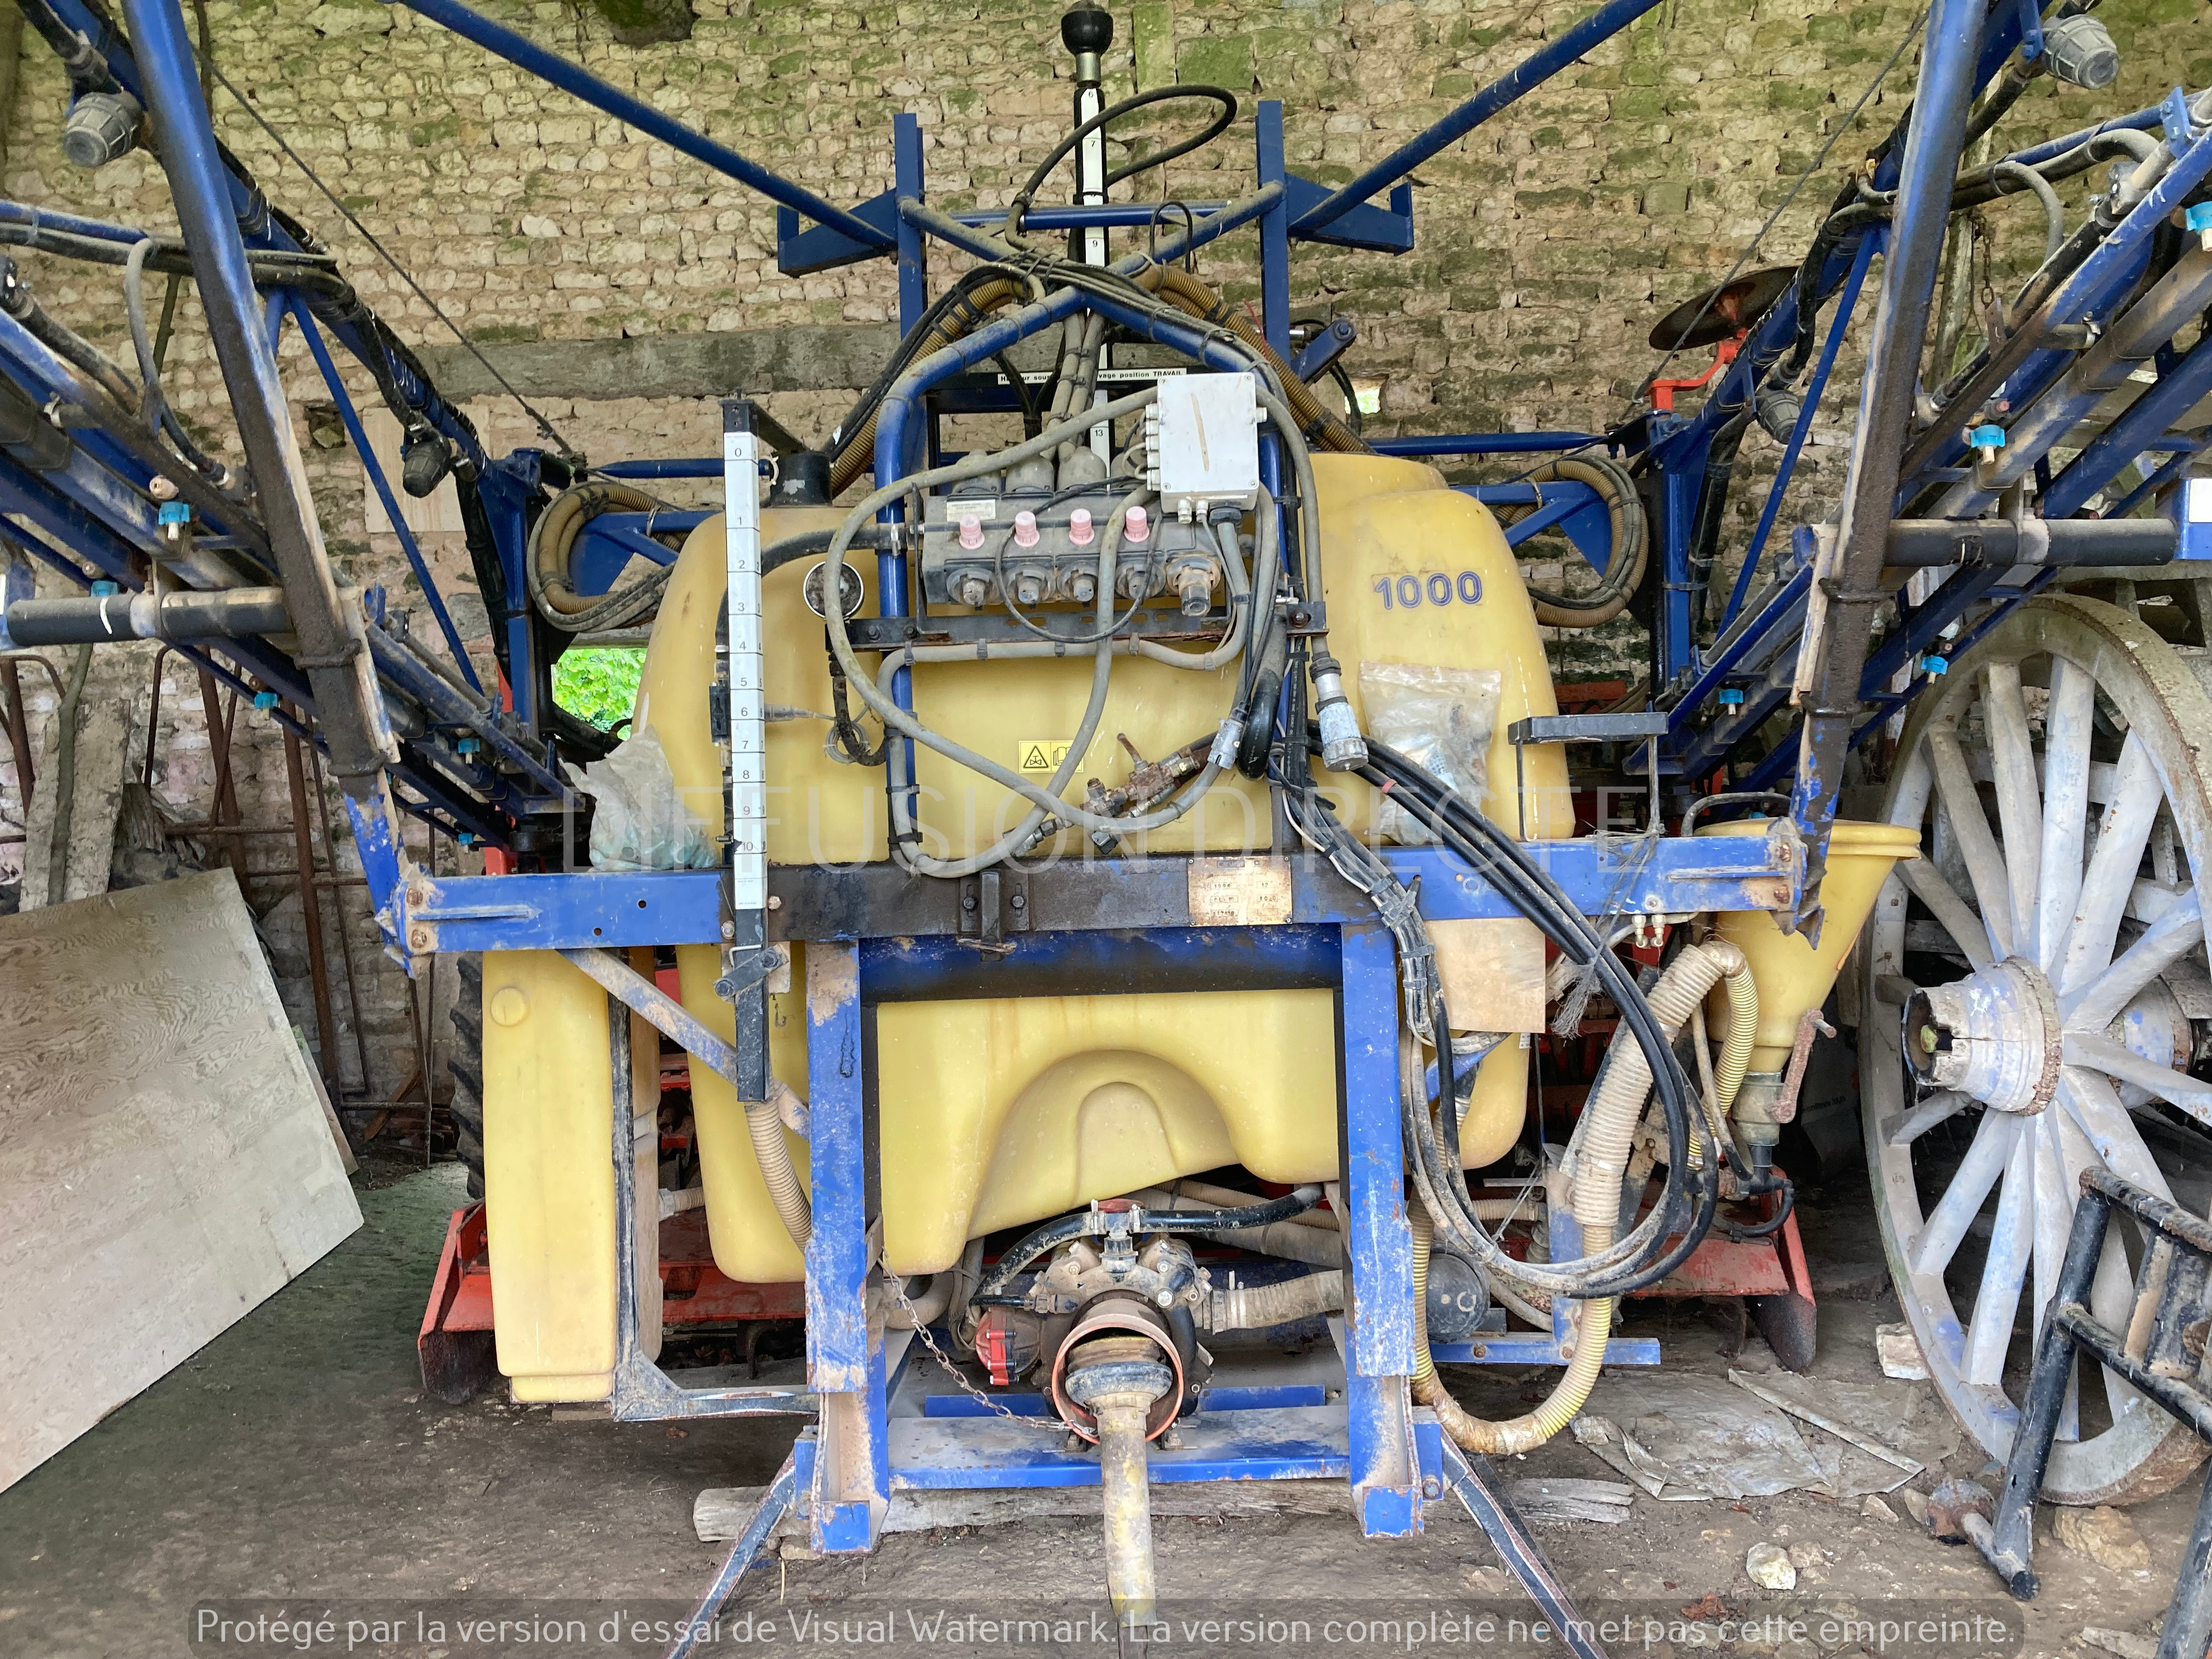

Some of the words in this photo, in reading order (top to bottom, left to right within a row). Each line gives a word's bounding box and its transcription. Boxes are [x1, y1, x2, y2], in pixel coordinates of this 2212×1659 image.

[735, 448, 742, 457] 0
[737, 516, 742, 526] 1
[738, 560, 746, 569] 2
[1374, 571, 1483, 610] 1000
[737, 602, 745, 612] 3
[739, 641, 747, 651] 4
[740, 677, 747, 687] 5
[741, 707, 748, 716] 6
[742, 741, 748, 749] 7
[743, 770, 750, 780] 8
[743, 805, 751, 815] 9
[742, 842, 753, 851] 10
